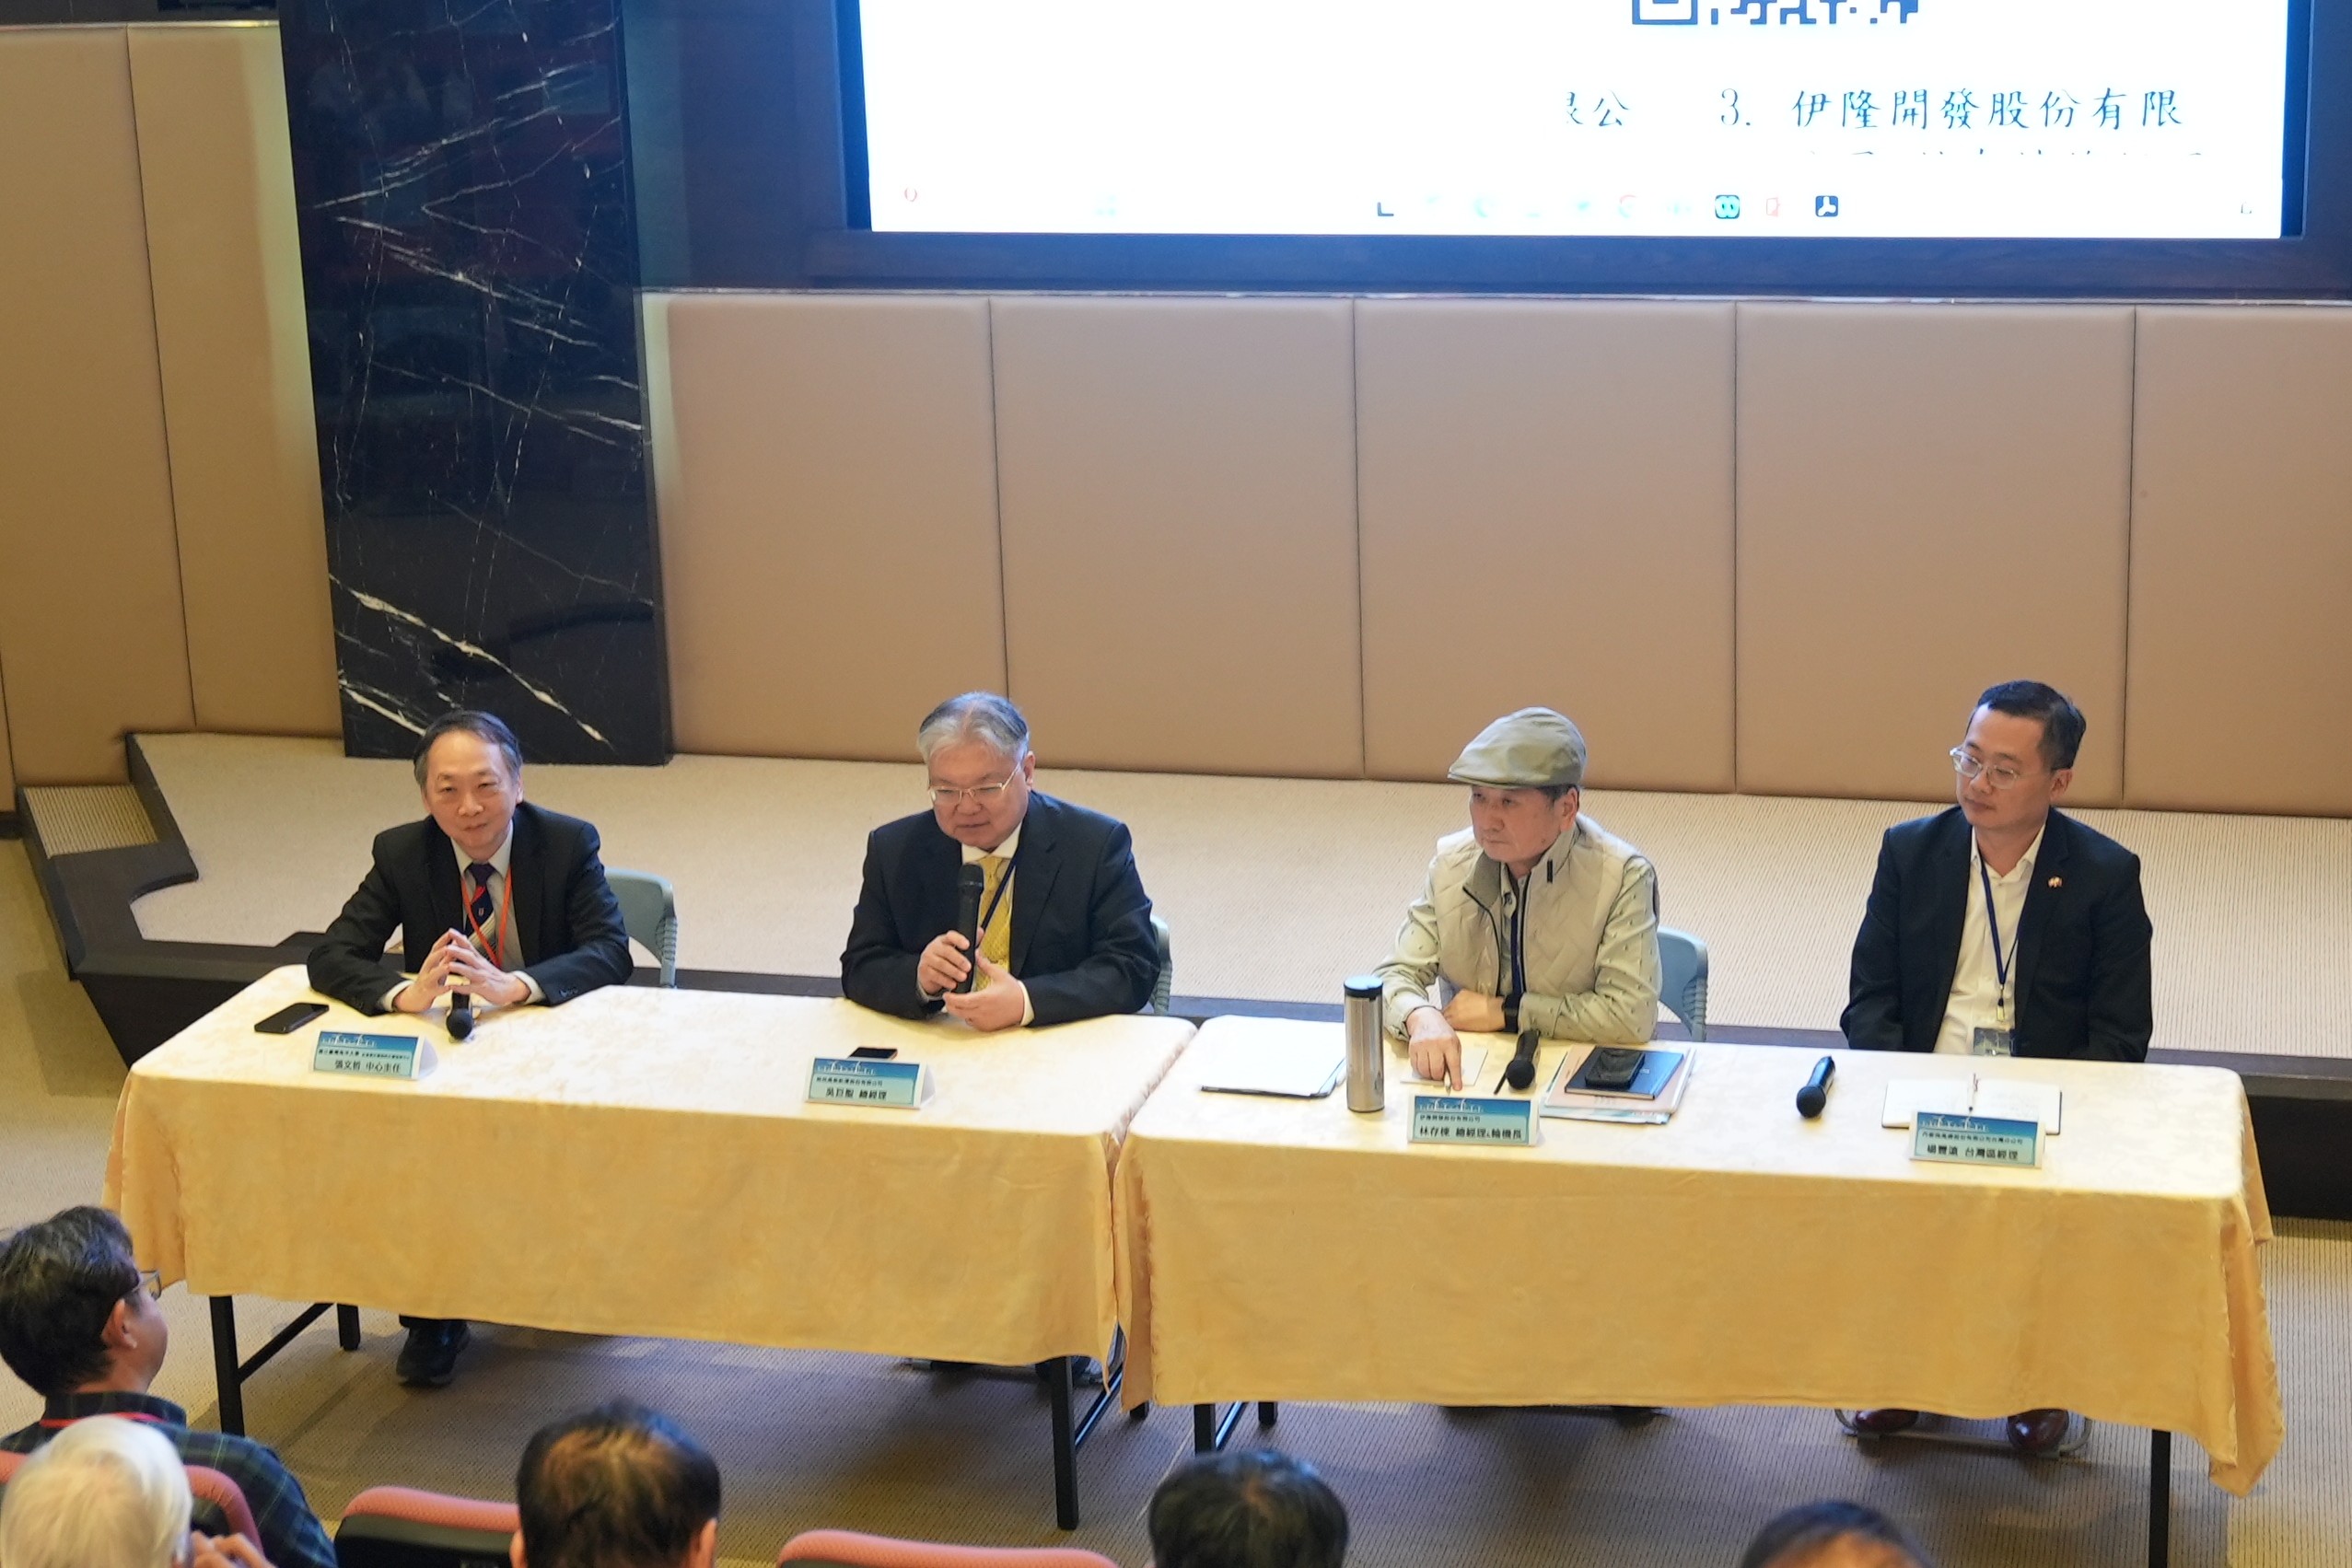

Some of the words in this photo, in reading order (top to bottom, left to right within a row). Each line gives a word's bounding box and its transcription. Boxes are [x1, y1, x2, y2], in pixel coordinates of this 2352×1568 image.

[1719, 87, 1752, 127] 3.
[1791, 87, 2185, 129] 伊隆開發股份有限
